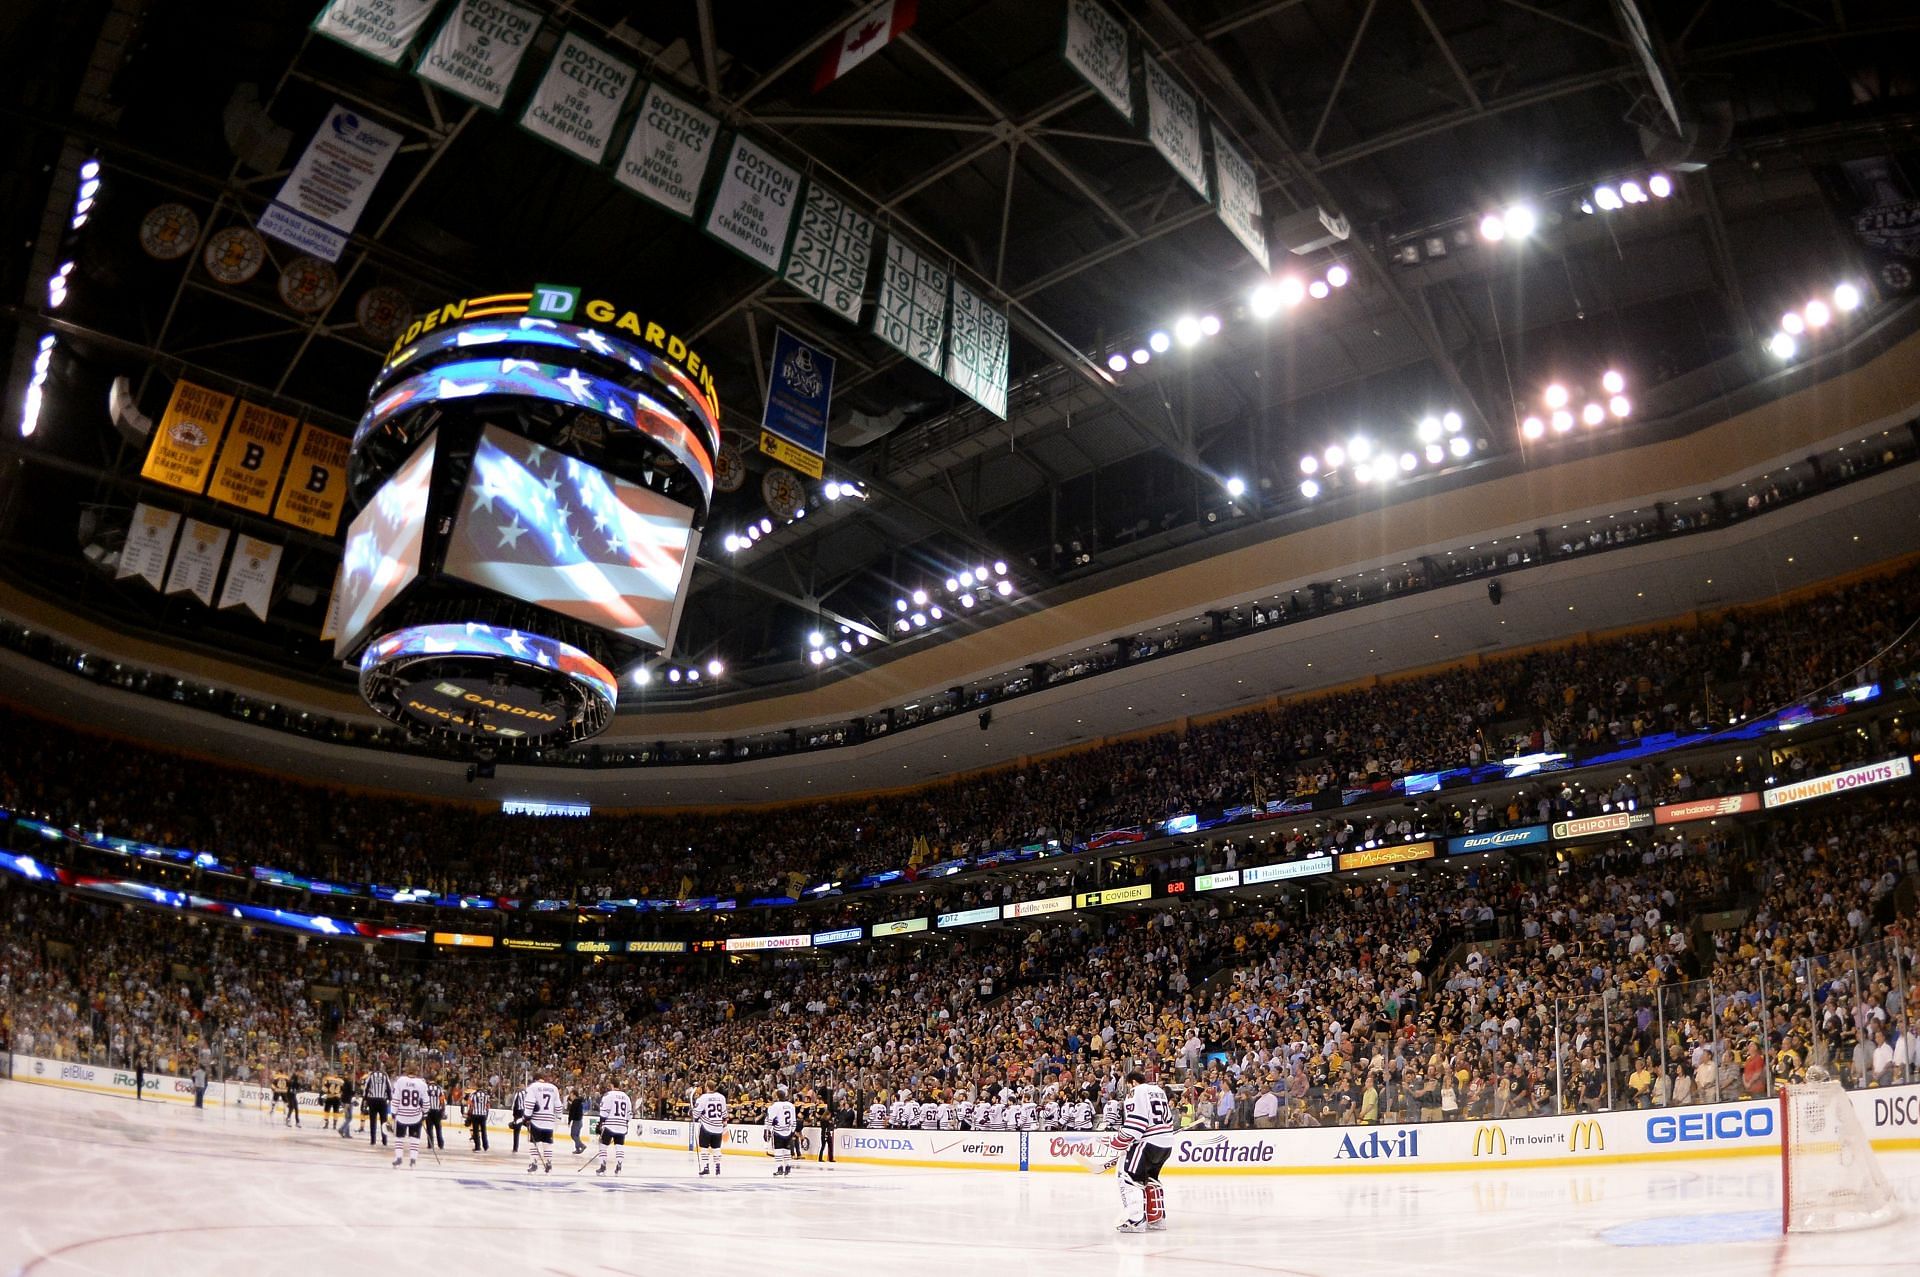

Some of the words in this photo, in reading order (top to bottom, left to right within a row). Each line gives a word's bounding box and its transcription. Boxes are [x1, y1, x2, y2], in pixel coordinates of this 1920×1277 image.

[354, 5, 396, 31] WORLD
[462, 10, 523, 46] CELTICS
[467, 0, 532, 33] BOSTON
[331, 10, 400, 49] CHAMPIONS
[452, 50, 493, 76] WORLD
[466, 42, 490, 61] 1981
[430, 54, 500, 94] CHAMPIONS
[564, 44, 627, 88] BOSTON
[560, 61, 619, 100] CELTICS
[552, 102, 592, 130] WORLD
[565, 94, 590, 114] 1984
[532, 106, 601, 149] CHAMPIONS
[651, 96, 712, 138] BOSTON
[647, 112, 702, 152] CELTICS
[643, 157, 682, 184] WORLD
[654, 149, 678, 168] 1986
[736, 148, 794, 192] BOSTON
[625, 161, 692, 203] CHAMPIONS
[734, 165, 787, 206] CELTICS
[732, 209, 768, 237] WORLD
[740, 200, 764, 222] 2008
[809, 186, 838, 220] 22
[848, 212, 868, 240] 14
[302, 227, 337, 247] LOWELL
[718, 216, 776, 256] CHAMPIONS
[803, 210, 832, 242] 23
[840, 234, 864, 265] 15
[798, 237, 826, 268] 21
[831, 258, 863, 290] 25
[896, 245, 903, 264] 1
[921, 262, 943, 290] 16
[788, 261, 820, 294] 24
[836, 290, 850, 312] 6
[888, 265, 910, 292] 19
[886, 290, 908, 316] 17
[960, 290, 972, 310] 3
[983, 307, 1006, 335] 33
[955, 310, 977, 341] 32
[385, 299, 467, 366] RDEN
[537, 288, 573, 312] TD
[586, 299, 714, 390] GARDEN
[882, 314, 903, 345] 10
[918, 340, 931, 363] 2
[953, 334, 974, 363] 00
[181, 386, 225, 410] BOSTON
[174, 400, 221, 425] BRUINS
[246, 407, 288, 432] BOSTON
[239, 420, 284, 446] BRUINS
[308, 430, 350, 452] BOSTON
[154, 456, 200, 477] CHAMPIONS
[241, 442, 264, 470] B
[302, 444, 348, 469] BRUINS
[220, 477, 266, 498] CHAMPIONS
[306, 464, 329, 492] B
[779, 486, 788, 501] 2
[285, 500, 331, 521] CHAMPIONS
[464, 693, 558, 722] GARDEN
[1779, 780, 1835, 803] DUNKIN'
[1836, 766, 1892, 789] DONUTS
[1670, 808, 1686, 817] new
[1686, 804, 1715, 814] balance
[1570, 816, 1626, 833] CHIPOTLE
[1464, 838, 1490, 848] BUD
[1496, 832, 1531, 843] LIGHT
[1360, 853, 1405, 865] Mohegan
[1408, 848, 1430, 856] Sun
[1214, 874, 1234, 884] Bank
[1262, 866, 1298, 878] Hallmark
[1300, 862, 1326, 872] Health
[1105, 889, 1142, 901] COVIDIEN
[1168, 882, 1185, 893] 8:20
[944, 914, 958, 923] DTZ
[576, 941, 610, 952] Gillette
[629, 942, 683, 952] SYLVANIA
[734, 940, 766, 948] DUNKIN'
[768, 938, 800, 946] DONUTS
[174, 1080, 193, 1092] Coo
[402, 1089, 420, 1108] 88
[542, 1094, 551, 1110] 7
[614, 1101, 626, 1117] 19
[708, 1104, 722, 1118] 29
[1150, 1100, 1172, 1124] 50
[1874, 1096, 1918, 1126] DISC
[784, 1111, 791, 1124] 2
[1646, 1107, 1774, 1144] GEICO
[653, 1127, 678, 1135] SiriusXM
[728, 1129, 748, 1144] VER
[1510, 1135, 1525, 1145] i'm
[1528, 1134, 1556, 1145] lovin'
[1558, 1132, 1565, 1144] it
[854, 1138, 914, 1150] HONDA
[962, 1142, 1004, 1156] verizon
[1050, 1136, 1094, 1158] Coors
[1178, 1140, 1274, 1162] Scottrade
[1334, 1129, 1418, 1160] Advil
